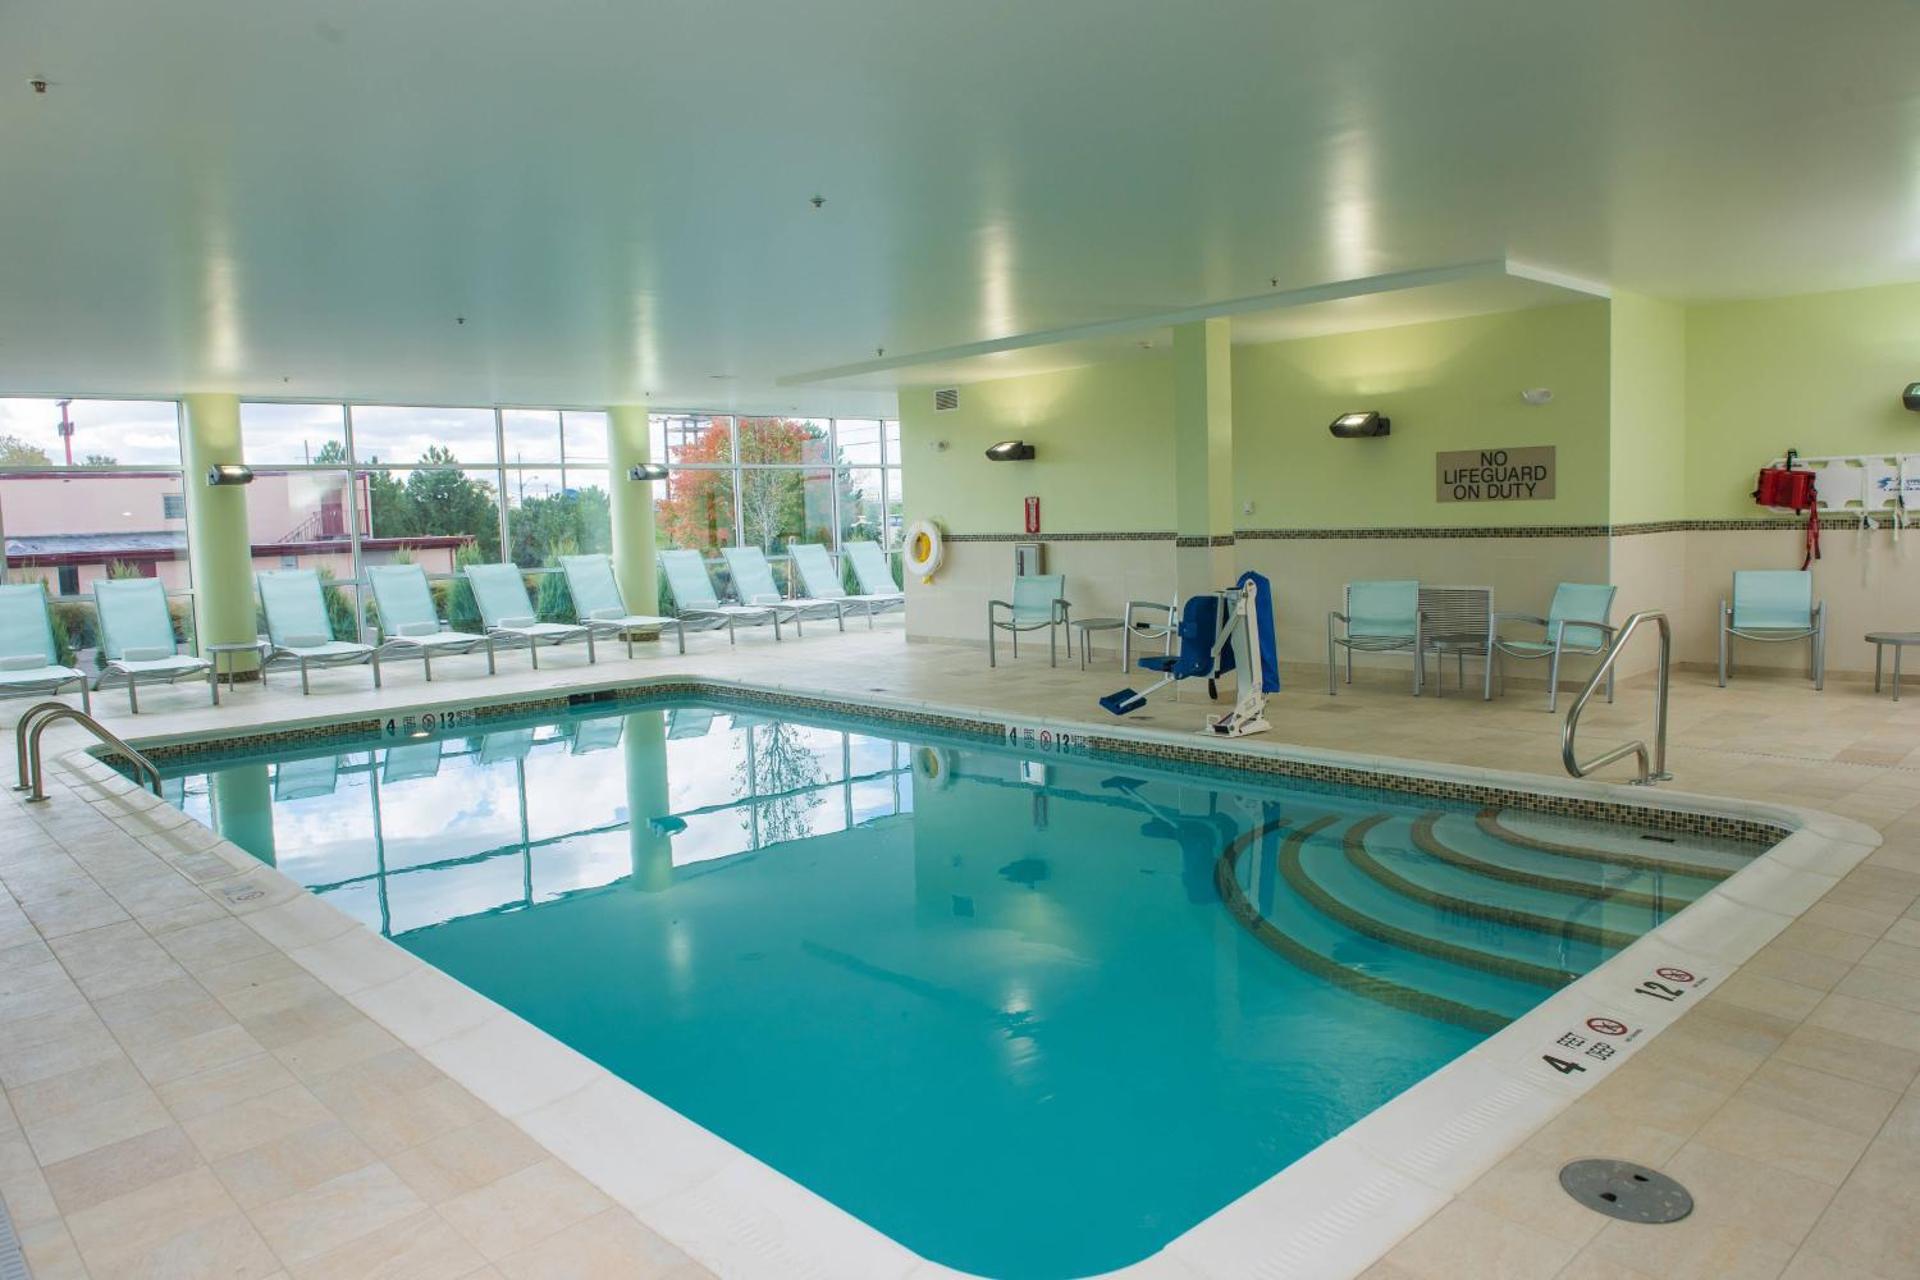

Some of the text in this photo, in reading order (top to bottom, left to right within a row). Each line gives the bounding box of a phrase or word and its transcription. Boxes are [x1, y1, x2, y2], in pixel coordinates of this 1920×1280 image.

[1480, 451, 1508, 466] NO
[1444, 465, 1547, 484] LIFEGUARD
[1453, 482, 1537, 499] ON DUTY
[1542, 1054, 1587, 1075] 4
